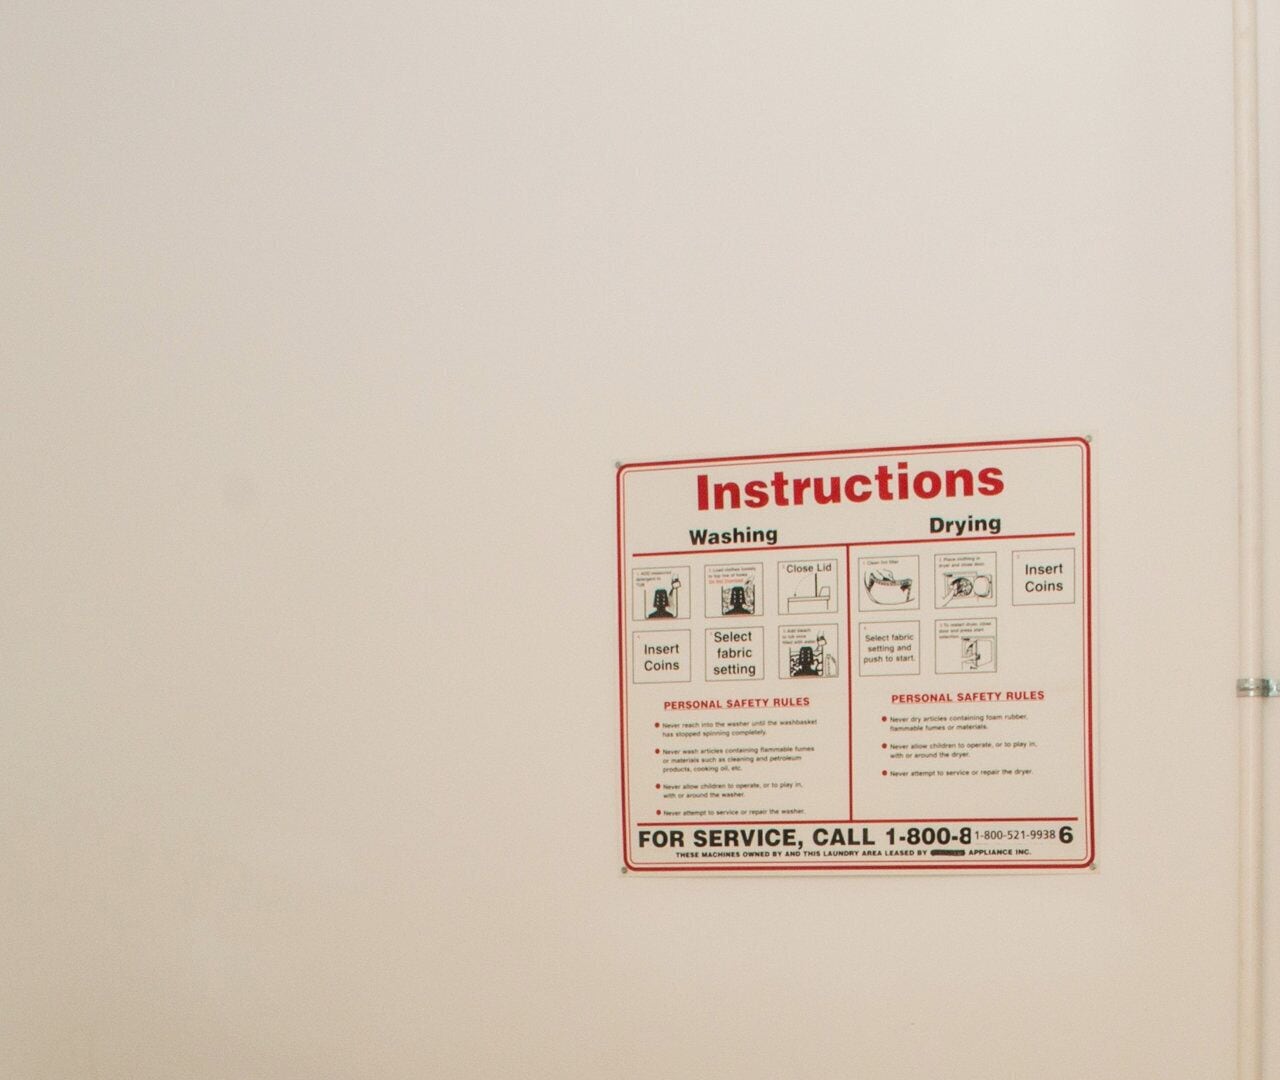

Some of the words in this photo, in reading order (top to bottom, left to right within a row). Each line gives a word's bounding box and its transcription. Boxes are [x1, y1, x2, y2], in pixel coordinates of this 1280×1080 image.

[697, 462, 1004, 510] Instructions
[928, 516, 1002, 537] Drying
[689, 527, 779, 547] Washing
[785, 564, 814, 574] Close
[816, 562, 832, 573] Lid
[1025, 563, 1063, 576] Insert
[1024, 580, 1064, 593] Coins
[713, 631, 752, 643] Select
[643, 643, 680, 655] Insert
[716, 647, 752, 659] fabric
[643, 660, 680, 672] Coins
[863, 655, 884, 665] push
[714, 664, 755, 677] setting
[663, 700, 722, 710] PERSONAL
[726, 698, 769, 709] SAFETY
[773, 697, 810, 707] RULES
[891, 693, 953, 704] PERSONAL
[956, 691, 1002, 702] SAFETY
[1006, 690, 1045, 701] RULES
[639, 830, 684, 848] FOR
[694, 829, 803, 849] SERVICE,
[813, 828, 875, 846] CALL
[974, 829, 1057, 841] 1-800-521-9938
